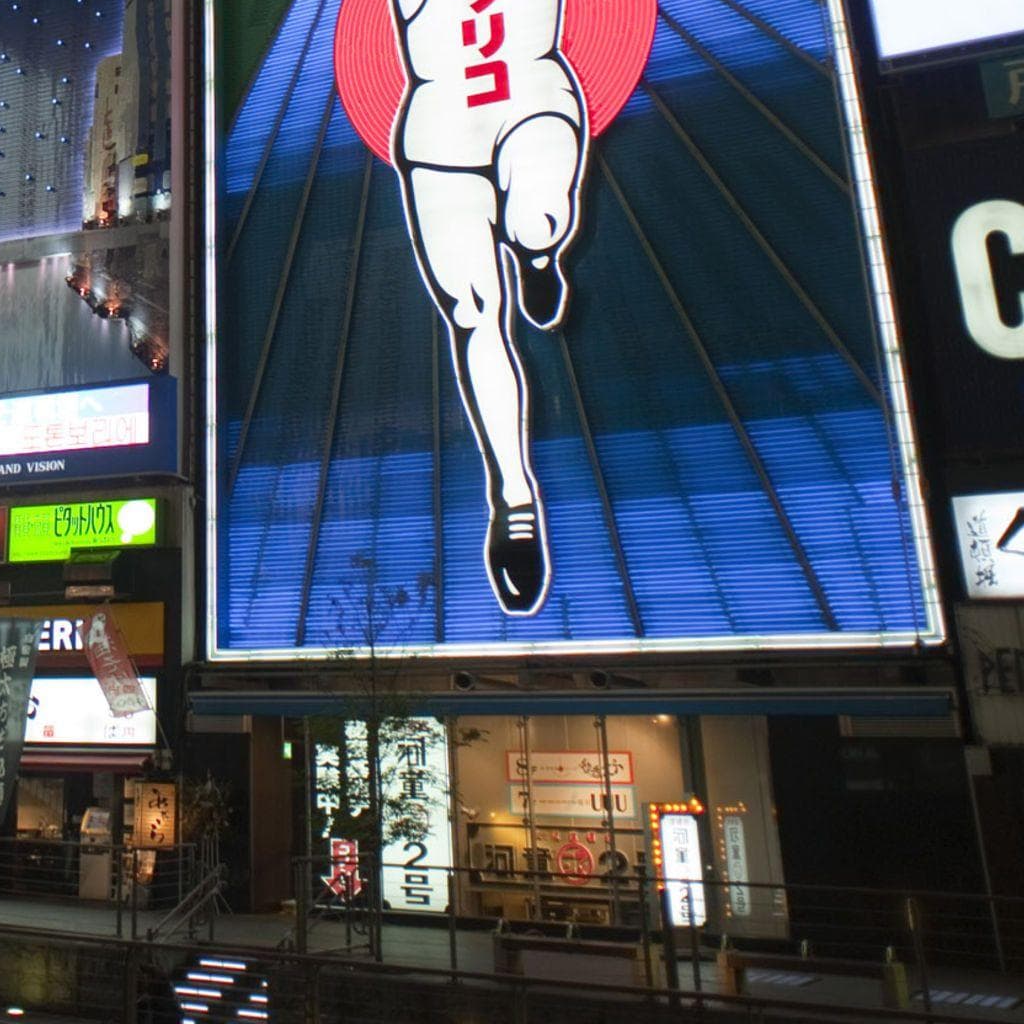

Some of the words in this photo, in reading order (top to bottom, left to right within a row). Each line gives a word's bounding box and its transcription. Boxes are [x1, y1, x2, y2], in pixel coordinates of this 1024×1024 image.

[26, 459, 66, 474] VISION
[54, 504, 115, 537] ピタットハウス
